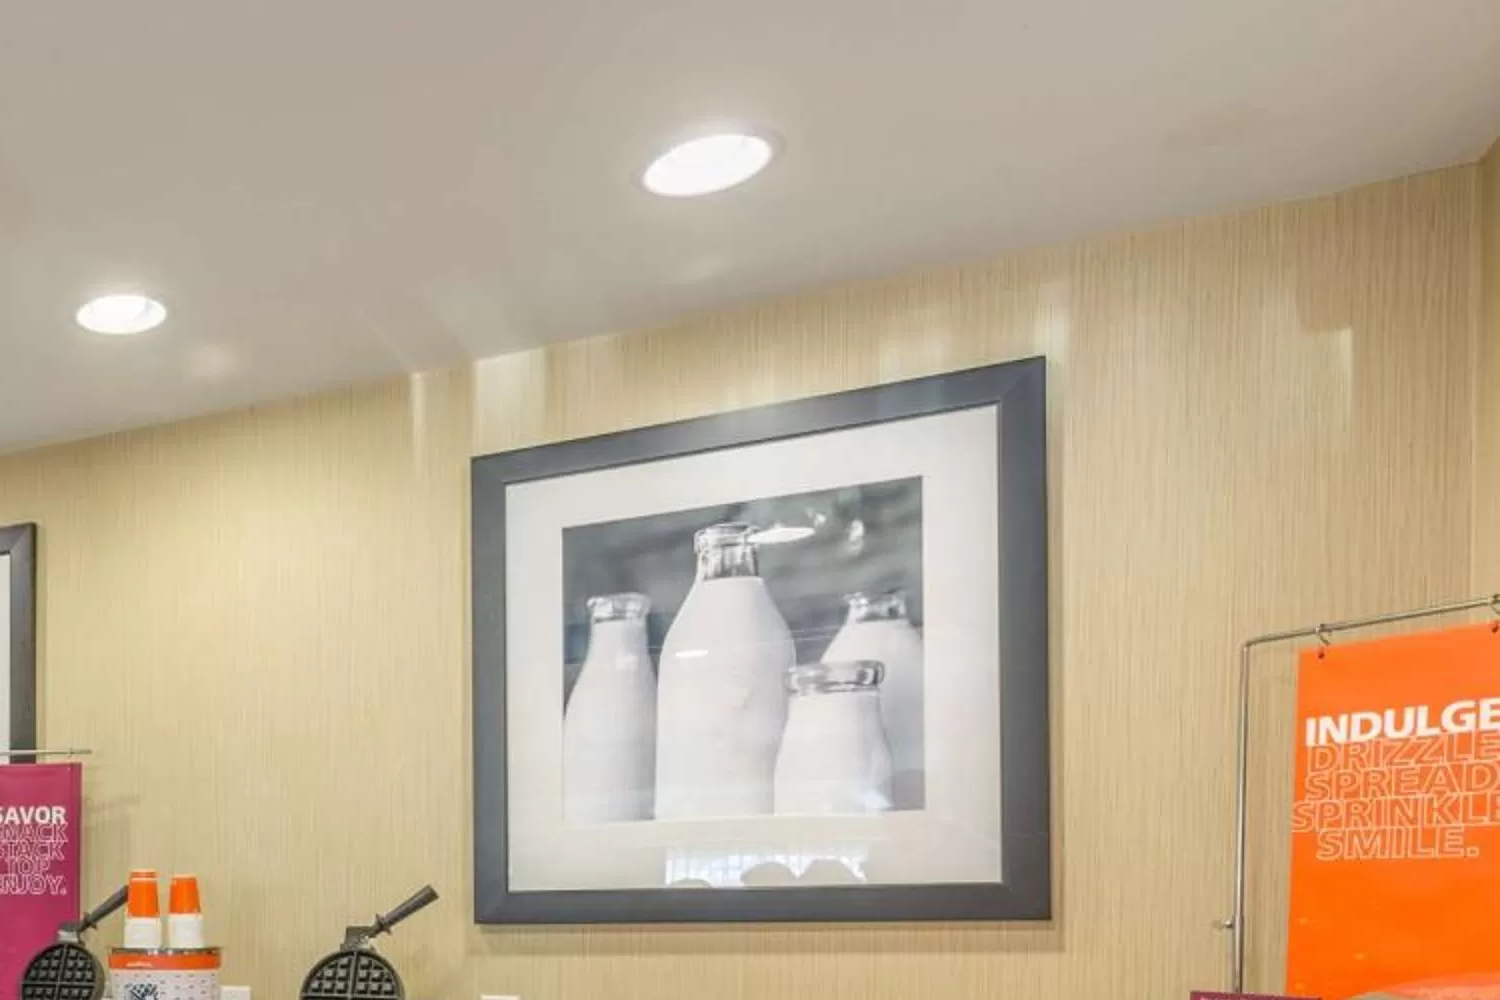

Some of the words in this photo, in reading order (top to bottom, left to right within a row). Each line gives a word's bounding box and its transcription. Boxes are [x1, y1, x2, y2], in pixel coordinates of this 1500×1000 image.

[1305, 697, 1500, 748] INDULGE
[1307, 731, 1500, 774] DRIZZLE
[1304, 761, 1500, 801] SPREAD
[1316, 824, 1480, 861] SMILE.
[5, 856, 51, 875] TOP
